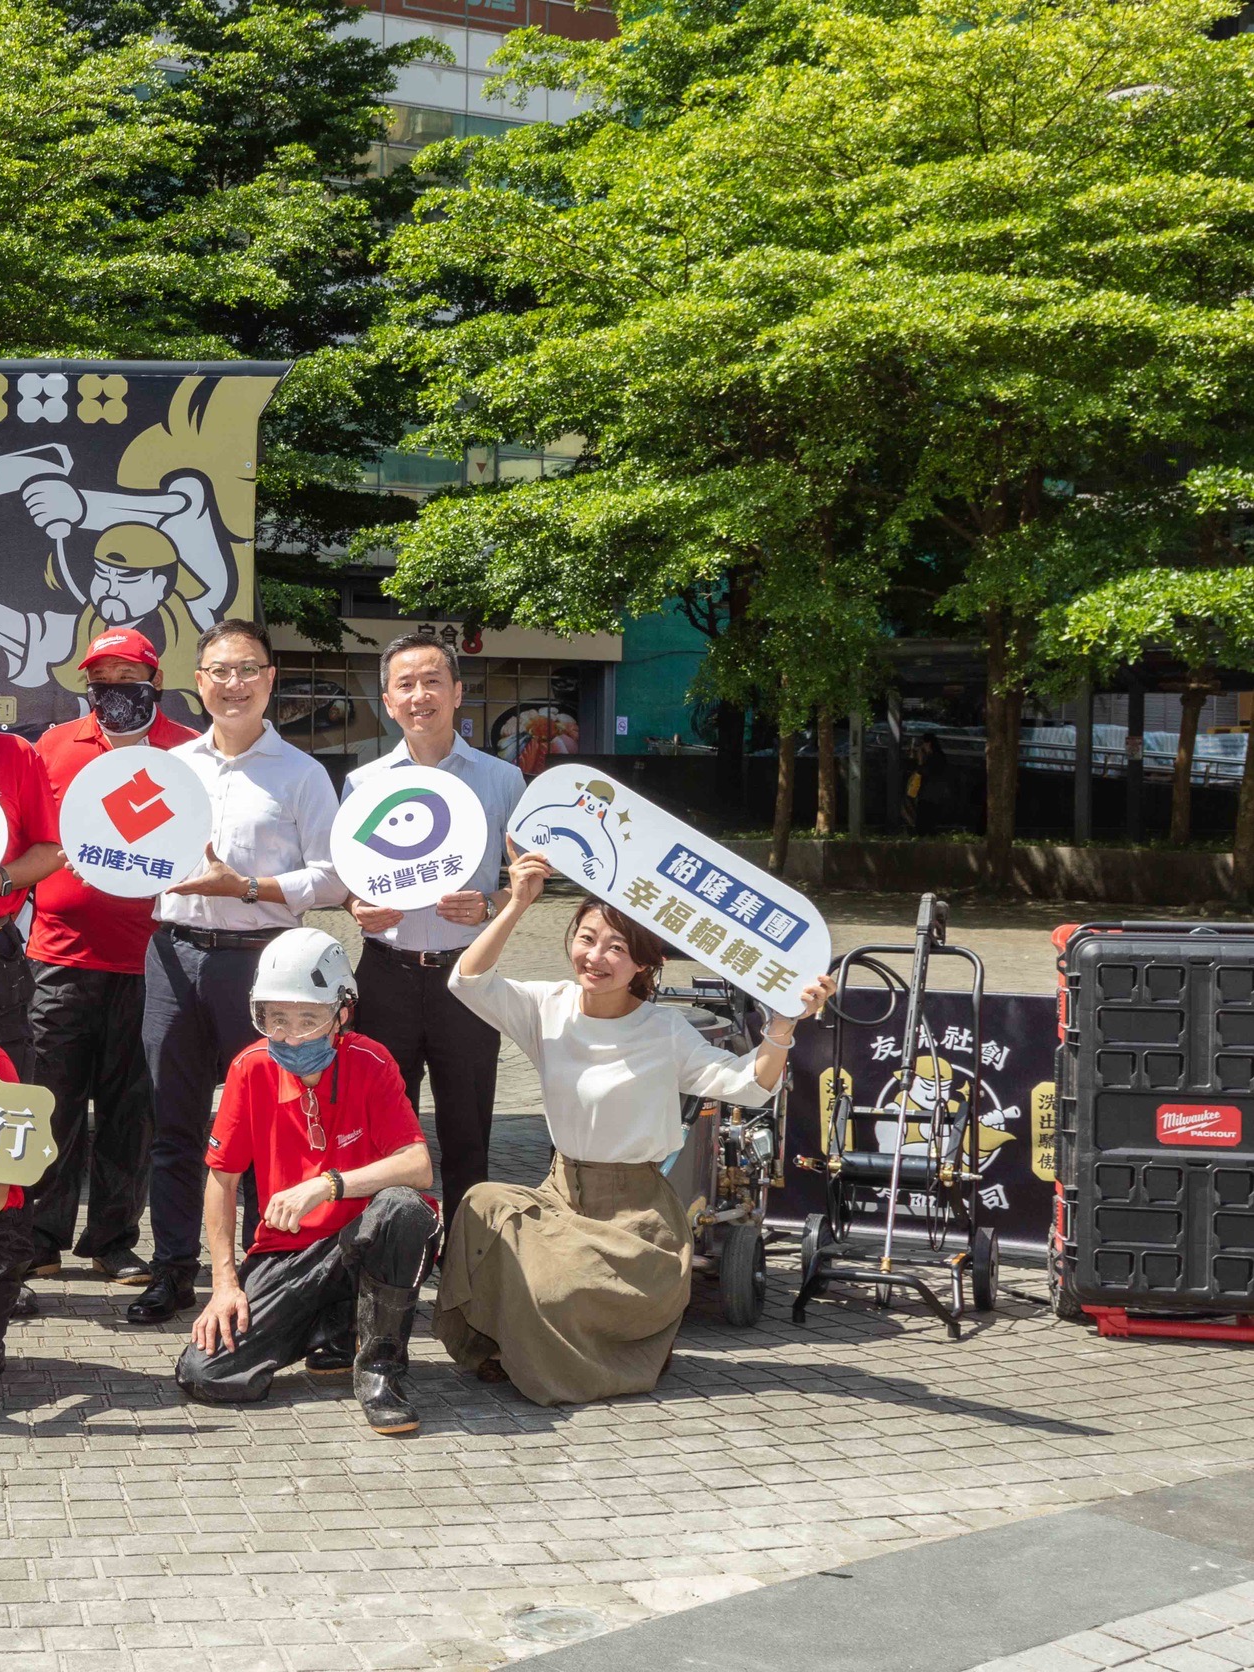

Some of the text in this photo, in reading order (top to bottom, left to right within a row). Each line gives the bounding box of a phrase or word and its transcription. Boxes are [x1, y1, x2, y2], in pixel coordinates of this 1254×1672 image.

[77, 843, 175, 881] 裕隆汽車
[366, 853, 465, 897] 裕豐管家
[666, 850, 800, 946] 裕隆集團
[621, 876, 800, 995] 幸福輪轉手
[1160, 1109, 1221, 1130] Milwaukee
[1190, 1130, 1237, 1138] PACKOUT
